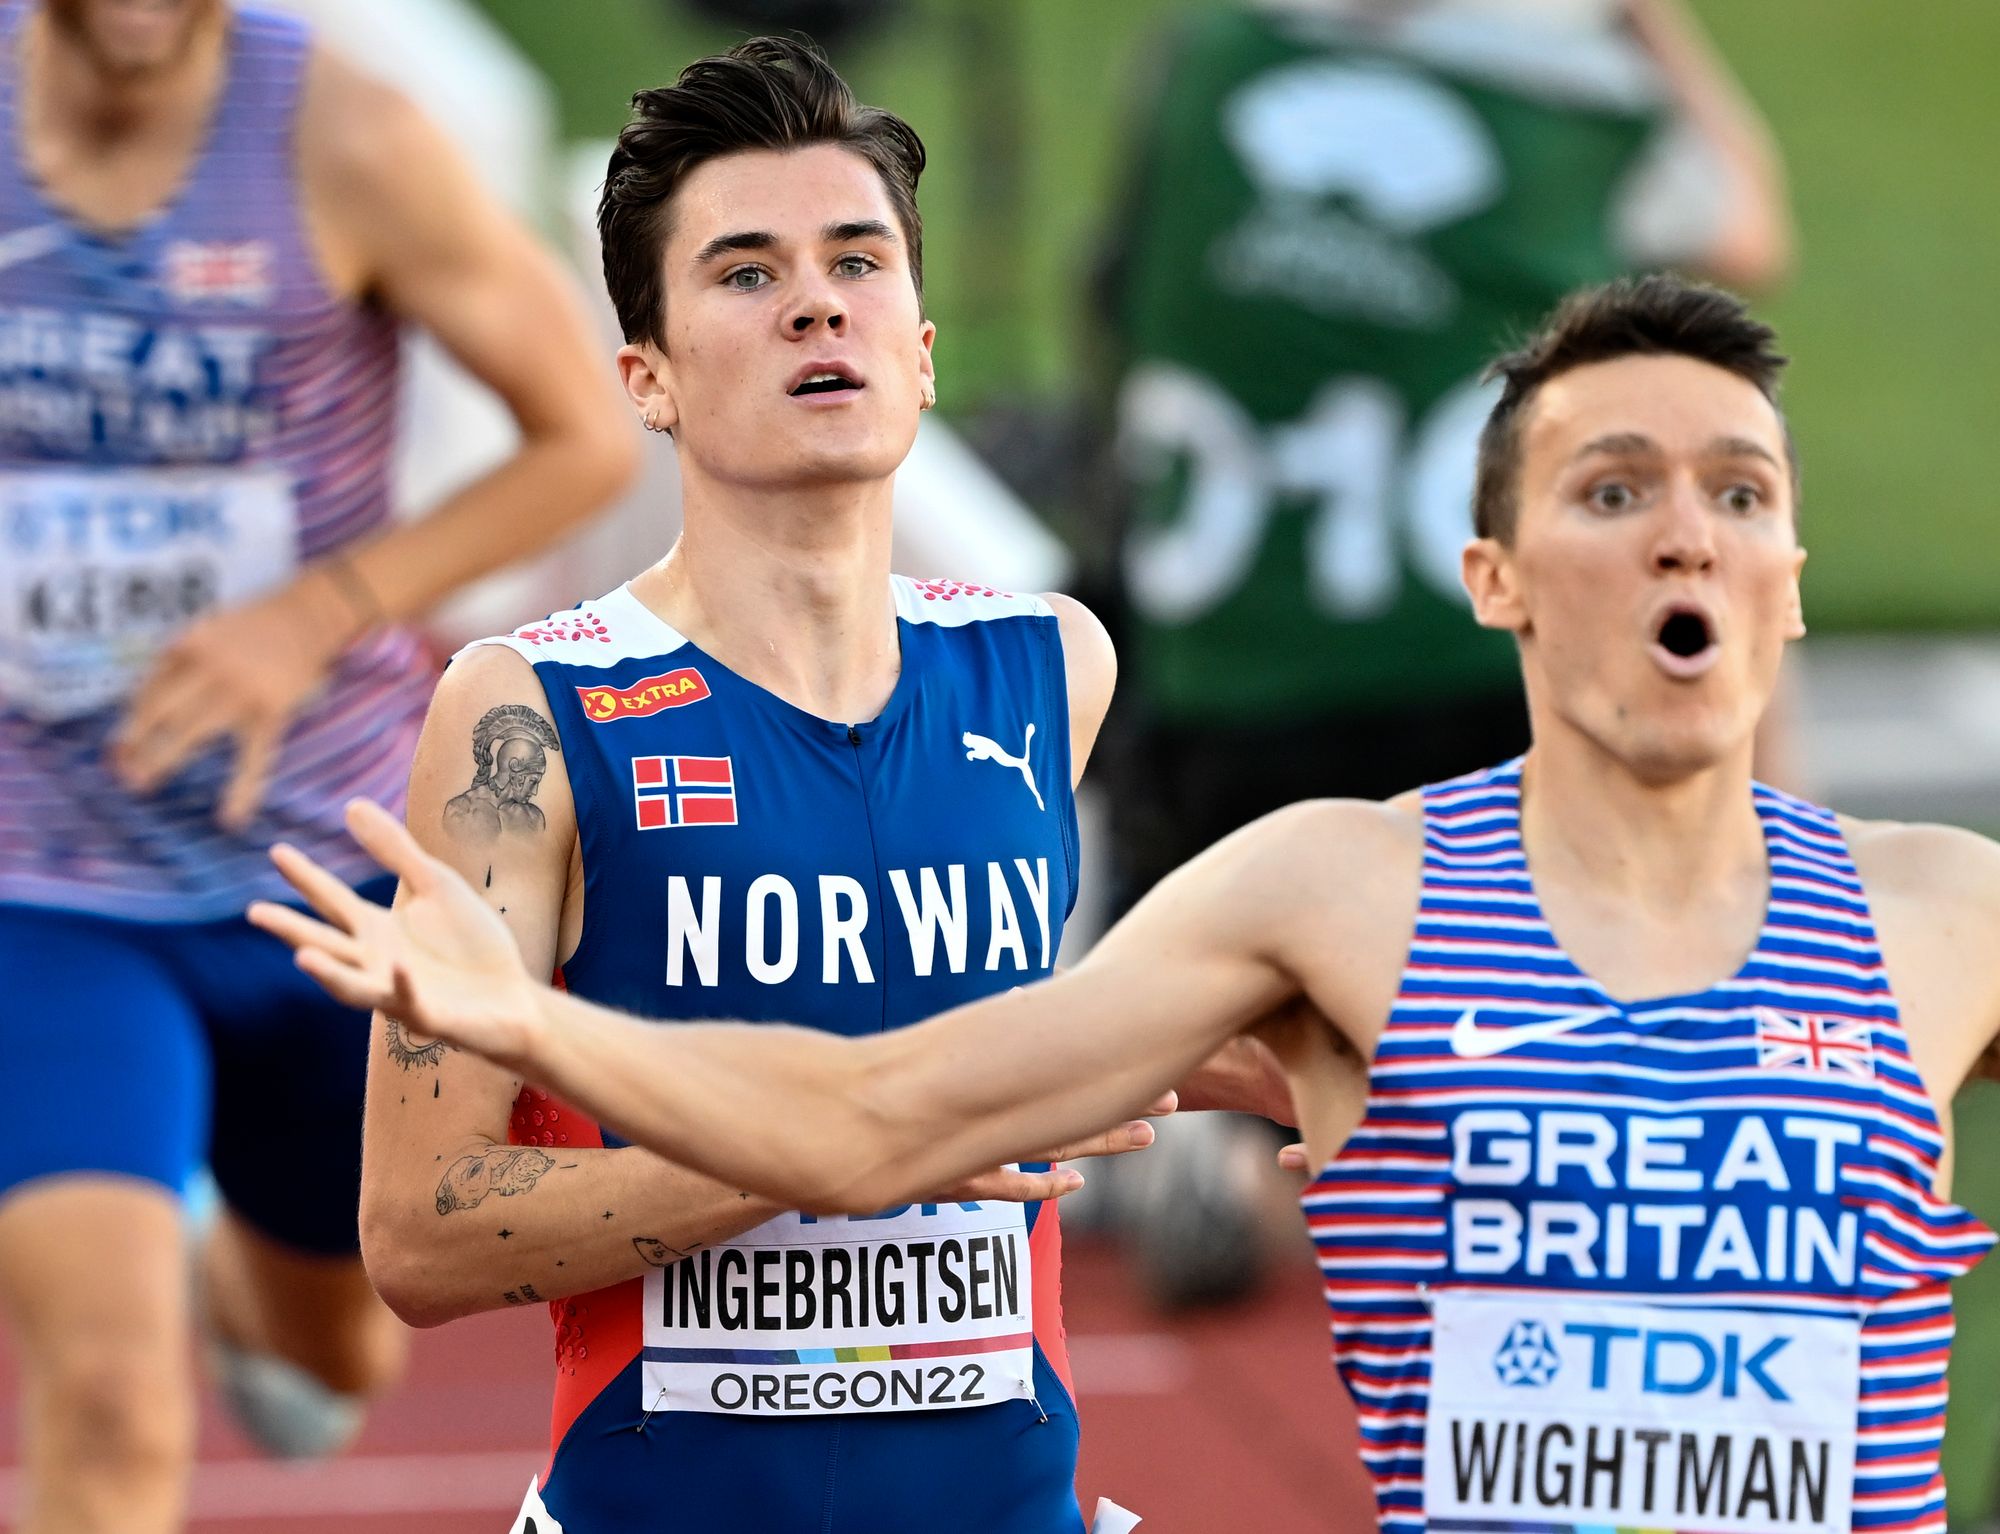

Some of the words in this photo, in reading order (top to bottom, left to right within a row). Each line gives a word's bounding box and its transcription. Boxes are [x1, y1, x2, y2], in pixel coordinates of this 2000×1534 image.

[0, 306, 277, 396] REAT
[620, 677, 698, 709] EXTRA
[666, 857, 1050, 987] NORWAY
[1451, 1110, 1861, 1193] GREAT
[663, 1233, 1019, 1331] INGEBRIGTSEN
[1452, 1200, 1858, 1286] BRITAIN
[711, 1363, 985, 1410] OREGON22
[1564, 1323, 1793, 1401] TDK
[1450, 1420, 1829, 1524] WIGHTMAN
